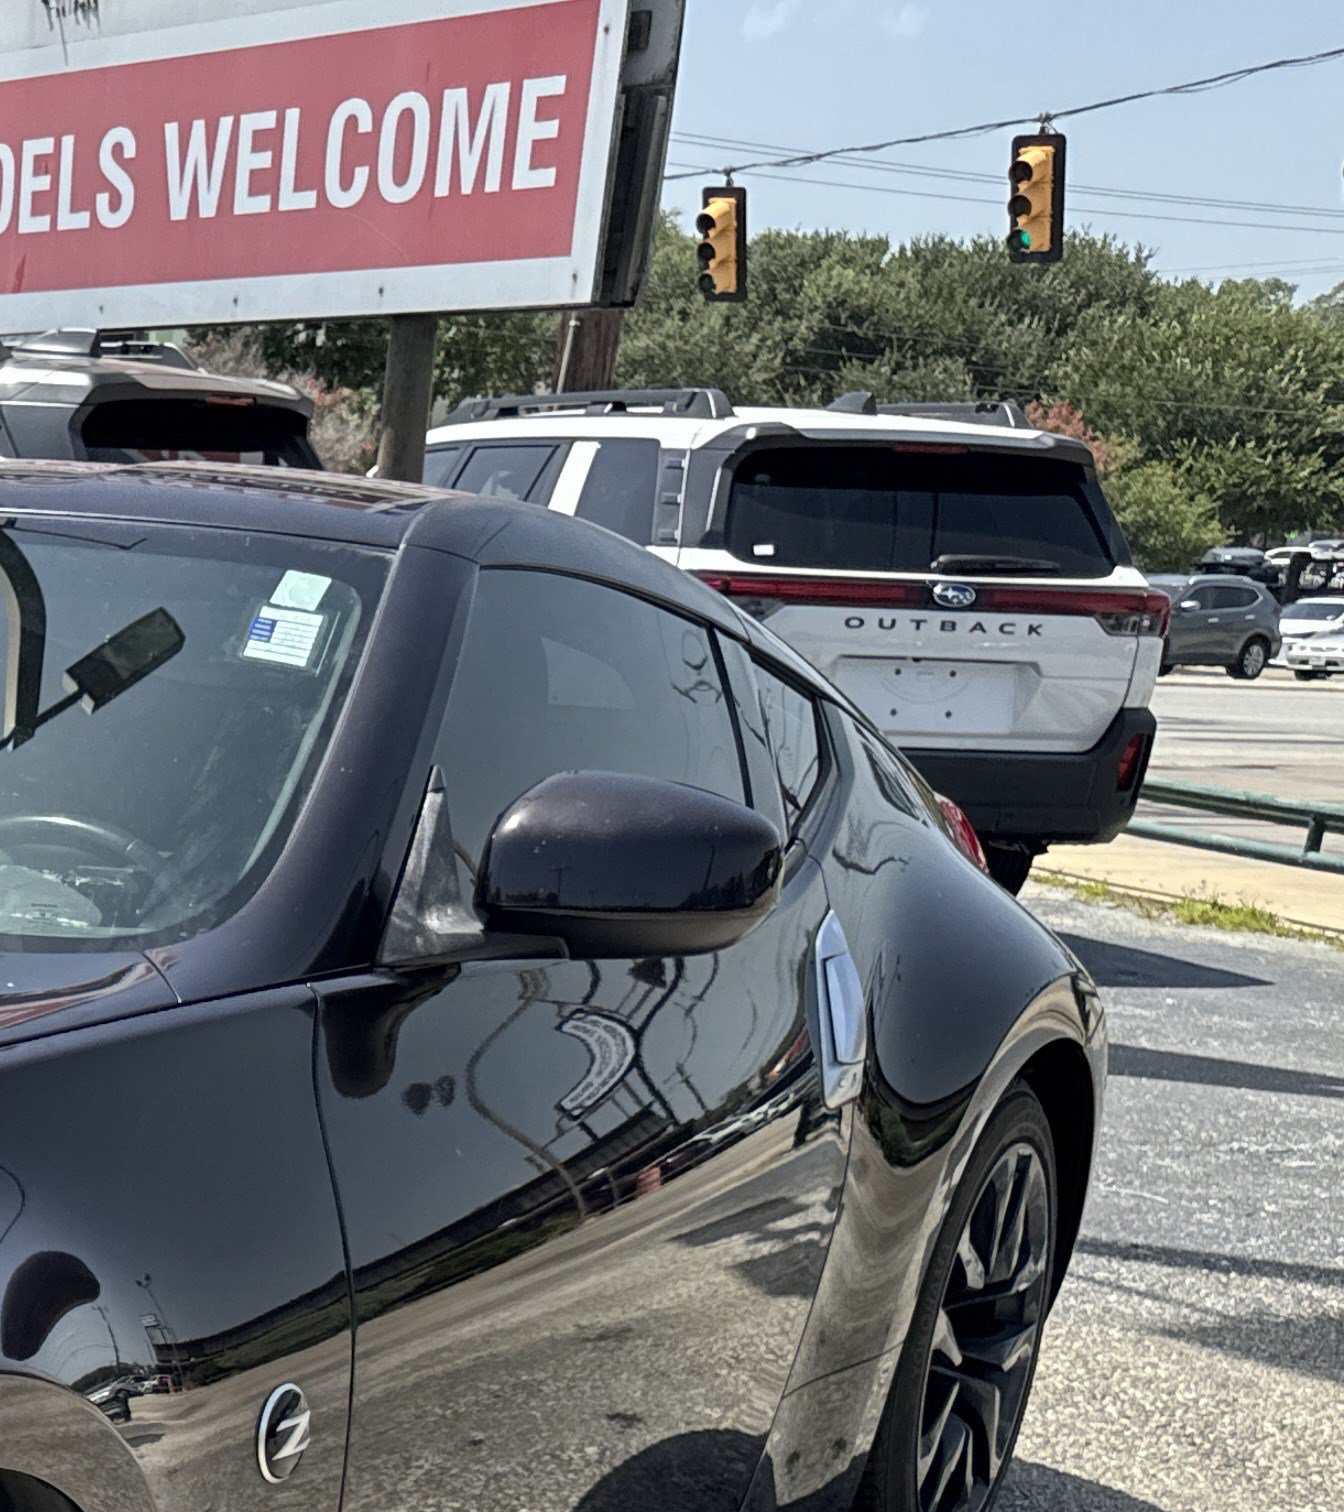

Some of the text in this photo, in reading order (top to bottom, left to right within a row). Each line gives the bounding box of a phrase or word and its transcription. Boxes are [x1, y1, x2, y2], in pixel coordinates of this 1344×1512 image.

[164, 75, 567, 221] WELCOME
[844, 616, 1043, 636] OUTBACK
[271, 1409, 311, 1461] Z
